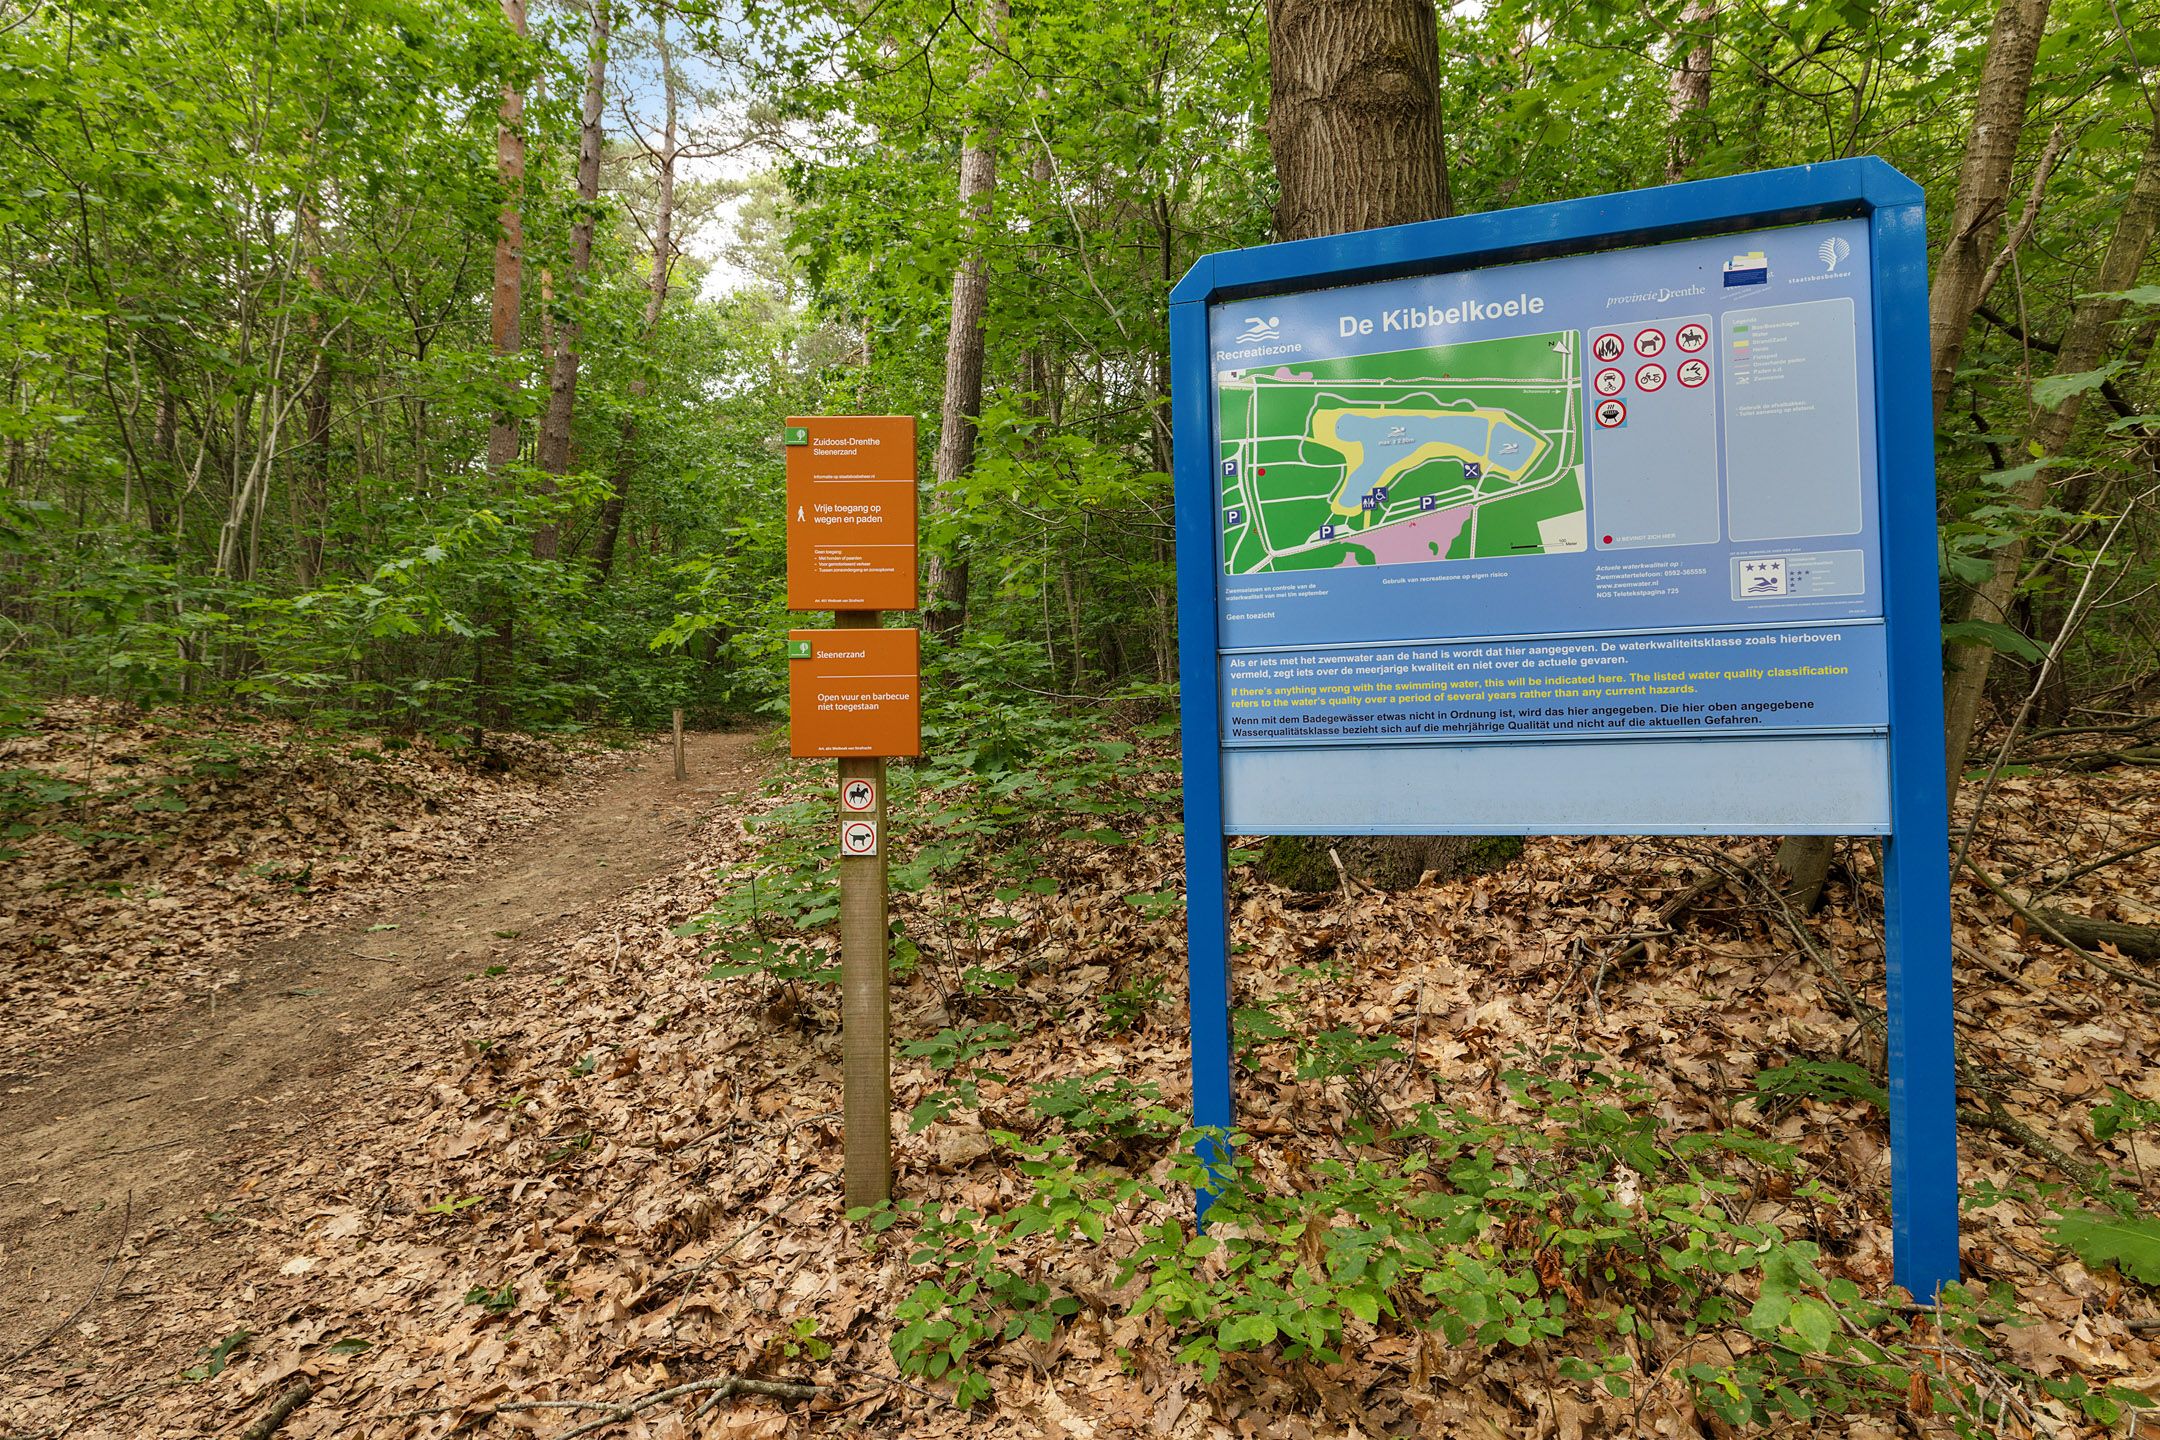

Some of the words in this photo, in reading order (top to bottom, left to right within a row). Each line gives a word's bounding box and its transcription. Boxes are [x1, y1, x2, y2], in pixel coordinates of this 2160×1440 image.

[1788, 271, 1852, 285] staatsbosbeheer
[1339, 315, 1374, 338] De
[1382, 293, 1545, 333] Kibbelkoele
[1216, 342, 1303, 362] Recreatiezone
[813, 438, 881, 446] Zuidoost-Drenthe
[813, 448, 858, 456] Sleenerzand
[814, 504, 833, 514] Vrije
[834, 505, 869, 514] toegang
[870, 505, 881, 513] op
[814, 516, 843, 525] wegen
[843, 516, 855, 524] en
[856, 515, 883, 525] paden
[1246, 612, 1275, 620] toezicht
[816, 651, 866, 659] Sleenerzand
[1230, 658, 1246, 668] Als
[1247, 659, 1258, 667] er
[1260, 658, 1278, 666] iets
[1279, 656, 1299, 666] met
[1300, 656, 1316, 665] het
[1318, 654, 1373, 664] zwemwater
[1376, 654, 1395, 662] aan
[1396, 651, 1410, 661] de
[1412, 650, 1438, 660] hand
[1440, 650, 1450, 659] is
[1452, 648, 1483, 658] wordt
[1485, 647, 1503, 657] dat
[1505, 646, 1526, 656] hier
[1528, 645, 1598, 656] aangegeven.
[1601, 642, 1616, 652] De
[1619, 638, 1742, 650] waterkwaliteitsklasse
[1745, 635, 1777, 645] zoals
[1780, 634, 1841, 643] hierboven
[1230, 670, 1271, 679] vermeld,
[1273, 669, 1295, 679] zegt
[1296, 668, 1314, 677] iets
[1316, 668, 1339, 676] over
[1340, 666, 1353, 675] de
[1355, 665, 1409, 675] meerjarige
[1411, 662, 1455, 672] kwaliteit
[1456, 663, 1470, 671] en
[1472, 661, 1493, 670] niet
[1495, 661, 1519, 669] over
[1522, 658, 1535, 668] de
[1538, 657, 1578, 667] actuele
[1580, 656, 1628, 667] gevaren.
[1231, 687, 1238, 697] If
[1239, 688, 1273, 696] there's
[1274, 686, 1317, 696] anything
[1319, 685, 1351, 695] wrong
[1352, 683, 1374, 692] with
[1376, 683, 1393, 691] the
[1395, 682, 1448, 691] swimming
[1450, 680, 1481, 689] water,
[1484, 679, 1505, 687] this
[1507, 677, 1526, 686] will
[1528, 677, 1542, 686] be
[1544, 675, 1596, 685] indicated
[1630, 672, 1651, 682] The
[1653, 671, 1686, 681] listed
[1688, 671, 1721, 680] water
[1723, 669, 1764, 680] quality
[1767, 666, 1849, 677] classification
[817, 693, 840, 702] Open
[872, 692, 910, 701] barbecue
[1231, 699, 1259, 708] refers
[1260, 699, 1271, 708] to
[1272, 698, 1289, 707] the
[1291, 698, 1327, 706] water's
[1328, 696, 1362, 706] quality
[1364, 696, 1387, 704] over
[1398, 693, 1432, 704] period
[1433, 692, 1445, 702] of
[1447, 691, 1485, 701] several
[1487, 692, 1517, 701] years
[1520, 690, 1552, 699] rather
[1554, 689, 1579, 697] than
[1582, 689, 1602, 698] any
[1605, 686, 1646, 696] current
[1649, 685, 1698, 694] hazards.
[817, 703, 834, 711] niet
[834, 703, 880, 712] toegestaan
[1232, 717, 1259, 725] Wenn
[1261, 716, 1277, 724] mit
[1279, 716, 1300, 724] dem
[1302, 714, 1374, 724] Badegewässer
[1376, 713, 1407, 721] etwas
[1409, 711, 1435, 720] nicht
[1437, 710, 1447, 720] in
[1450, 710, 1497, 720] Ordnung
[1499, 709, 1515, 718] ist,
[1518, 708, 1542, 717] wird
[1544, 707, 1565, 716] das
[1567, 706, 1589, 716] hier
[1591, 705, 1657, 717] angegeben.
[1660, 703, 1679, 713] Die
[1682, 703, 1705, 712] hier
[1708, 702, 1737, 712] oben
[1740, 701, 1815, 712] angegebene
[1232, 727, 1340, 737] Wasserqualitätsklasse
[1342, 725, 1378, 734] bezieht
[1381, 724, 1402, 734] sich
[1405, 723, 1421, 733] auf
[1424, 723, 1440, 732] die
[1442, 722, 1505, 733] mehrjährige
[1508, 720, 1550, 730] Qualität
[1552, 719, 1574, 729] und
[1576, 719, 1605, 728] nicht
[1607, 718, 1626, 728] auf
[1628, 717, 1646, 727] die
[1648, 716, 1701, 726] aktuellen
[1704, 715, 1762, 725] Gefahren.
